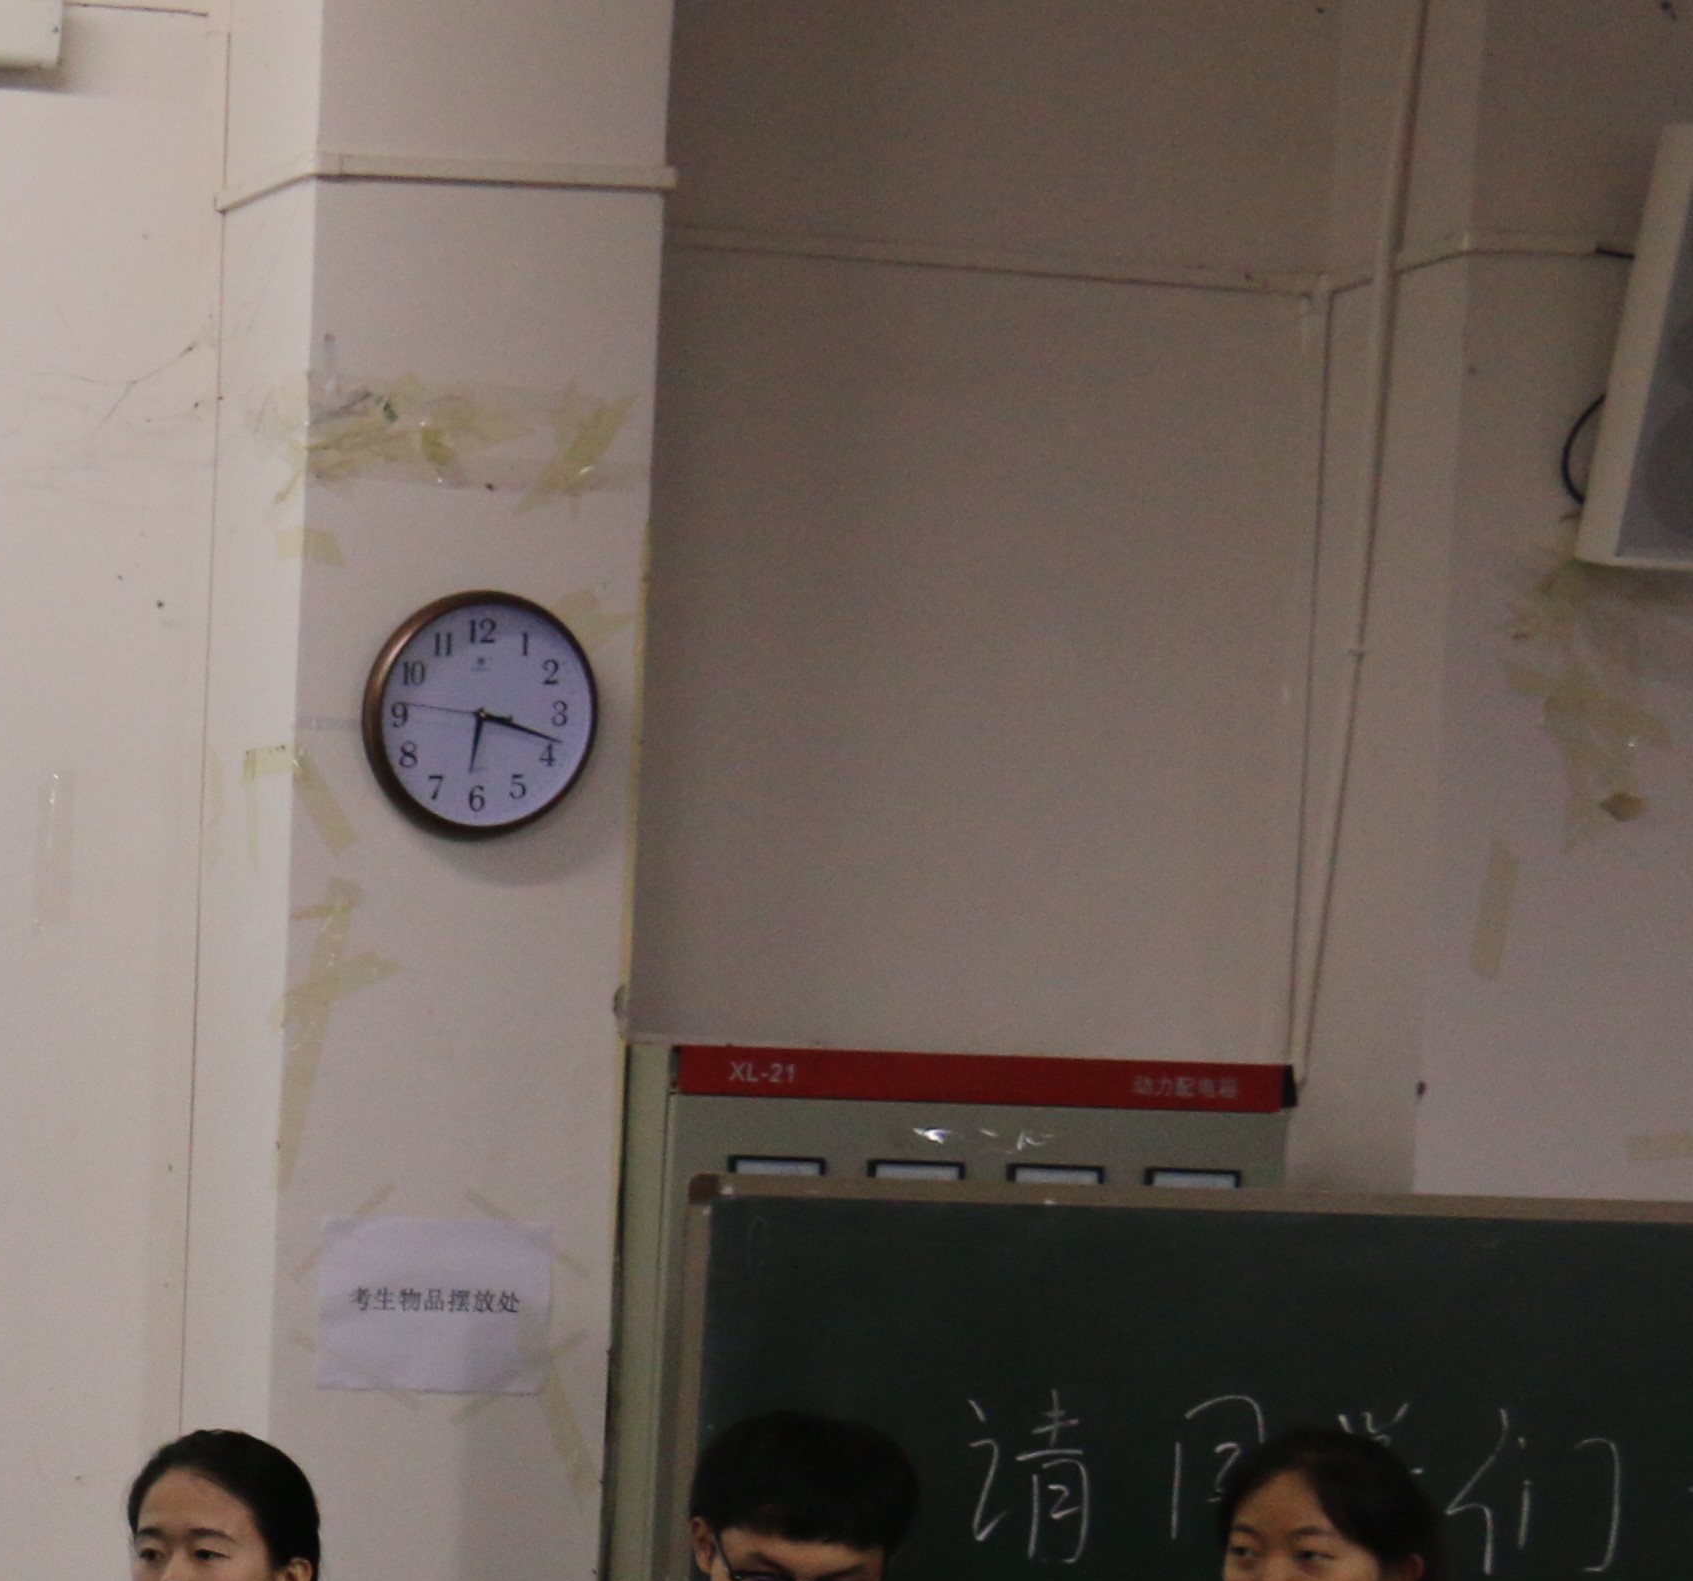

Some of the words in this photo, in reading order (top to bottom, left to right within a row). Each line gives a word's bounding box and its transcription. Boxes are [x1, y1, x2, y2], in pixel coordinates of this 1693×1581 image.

[434, 632, 453, 656] 11
[469, 618, 497, 644] 12
[521, 632, 529, 656] 1
[403, 660, 426, 686] 10
[542, 659, 560, 685] 2
[391, 701, 408, 728] 9
[551, 701, 568, 727] 3
[399, 741, 418, 768] 8
[539, 743, 556, 767] 4
[428, 775, 444, 800] 7
[469, 785, 486, 811] 6
[510, 774, 527, 799] 5
[729, 1061, 796, 1083] XL-21
[352, 1287, 520, 1314] 考生物品摆放处
